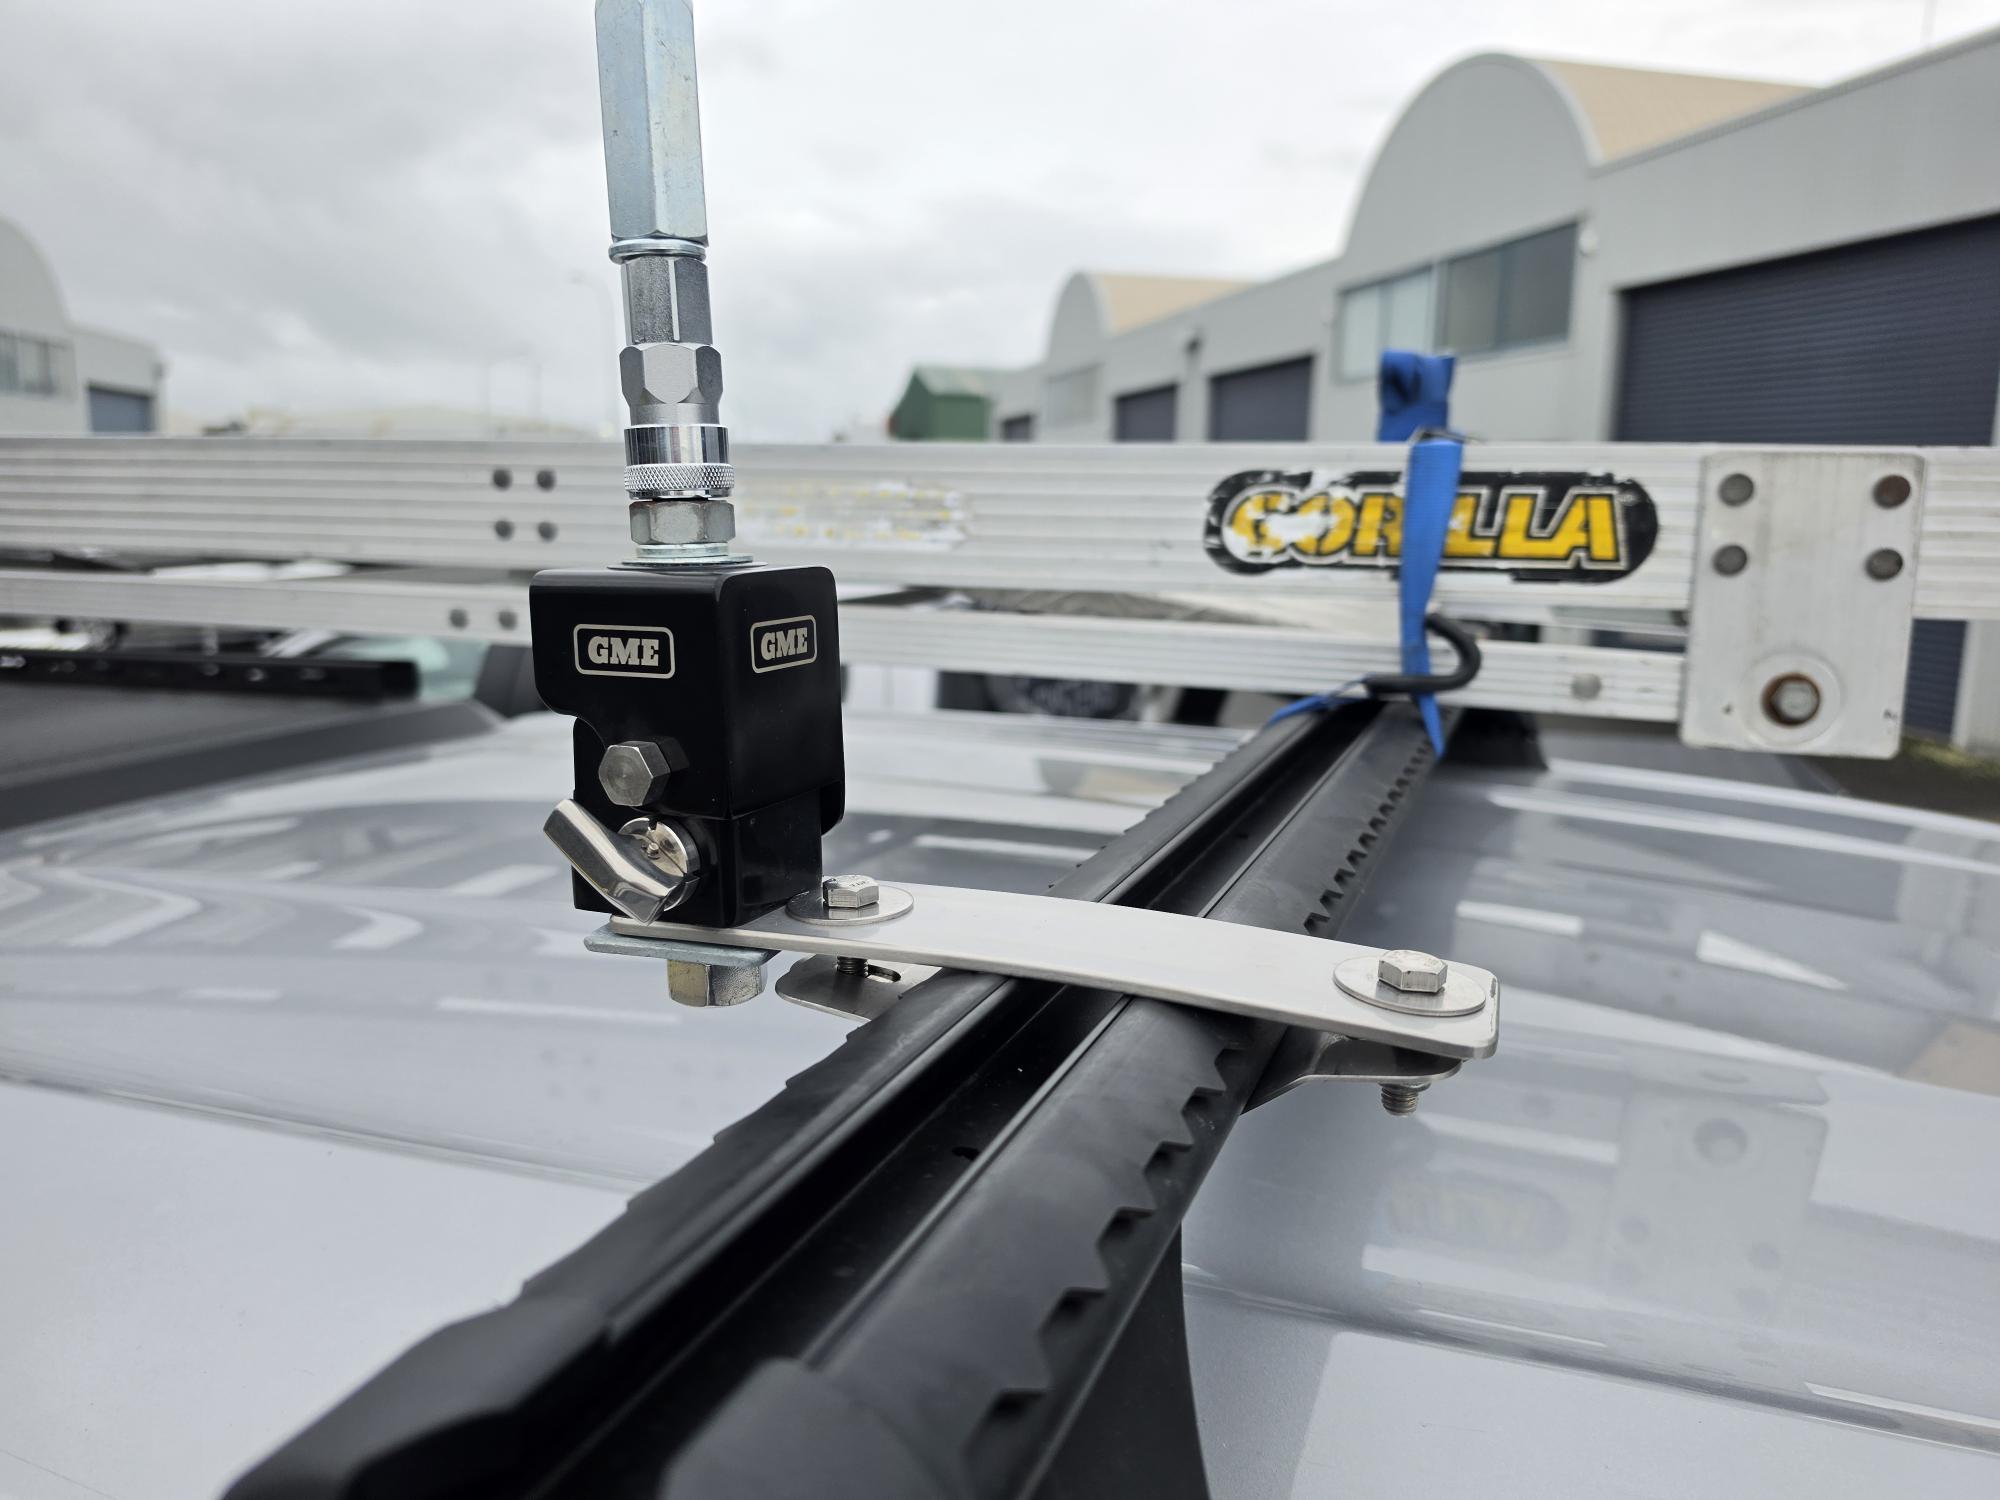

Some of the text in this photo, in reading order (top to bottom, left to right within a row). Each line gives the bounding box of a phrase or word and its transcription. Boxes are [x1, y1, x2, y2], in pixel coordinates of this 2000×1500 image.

[1224, 486, 1624, 567] GORLLA
[587, 635, 660, 667] GME
[760, 626, 808, 661] GME
